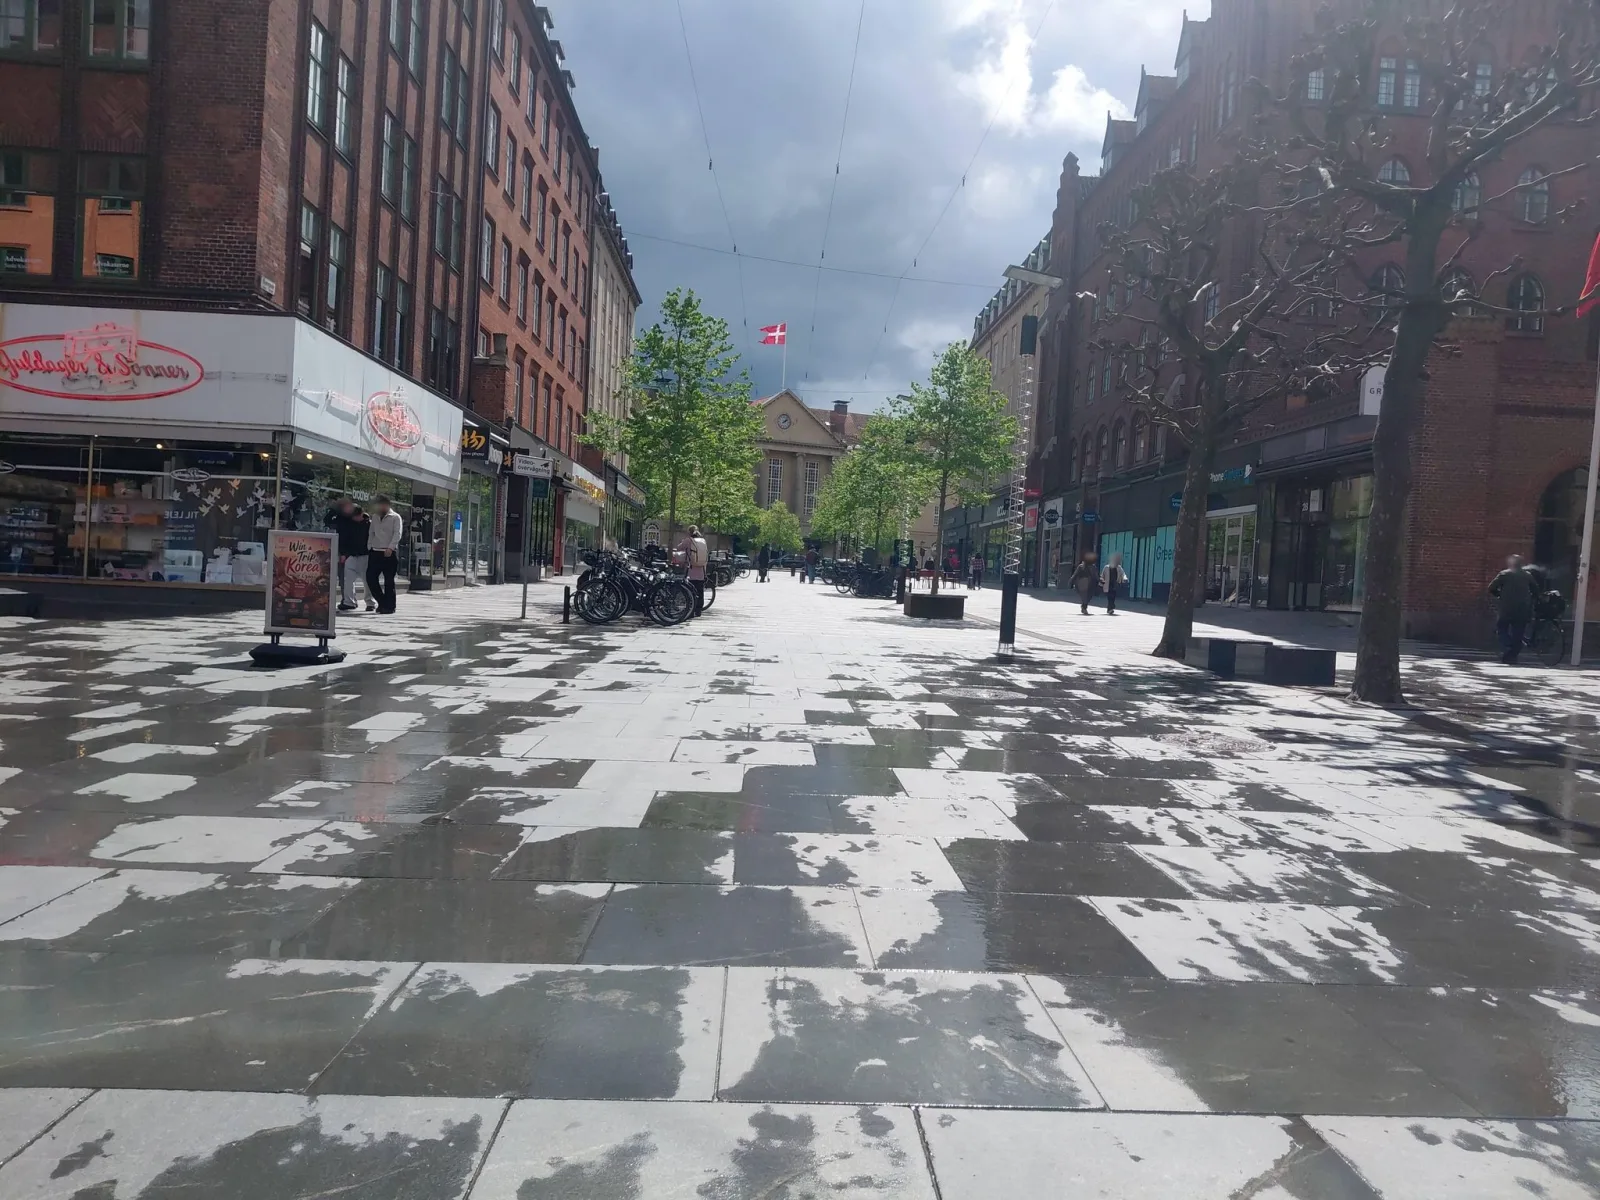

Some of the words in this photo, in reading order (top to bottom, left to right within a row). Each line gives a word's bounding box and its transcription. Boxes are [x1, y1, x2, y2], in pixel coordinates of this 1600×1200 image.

[289, 540, 306, 552] Win
[297, 551, 316, 562] Trip
[286, 558, 320, 574] Korea
